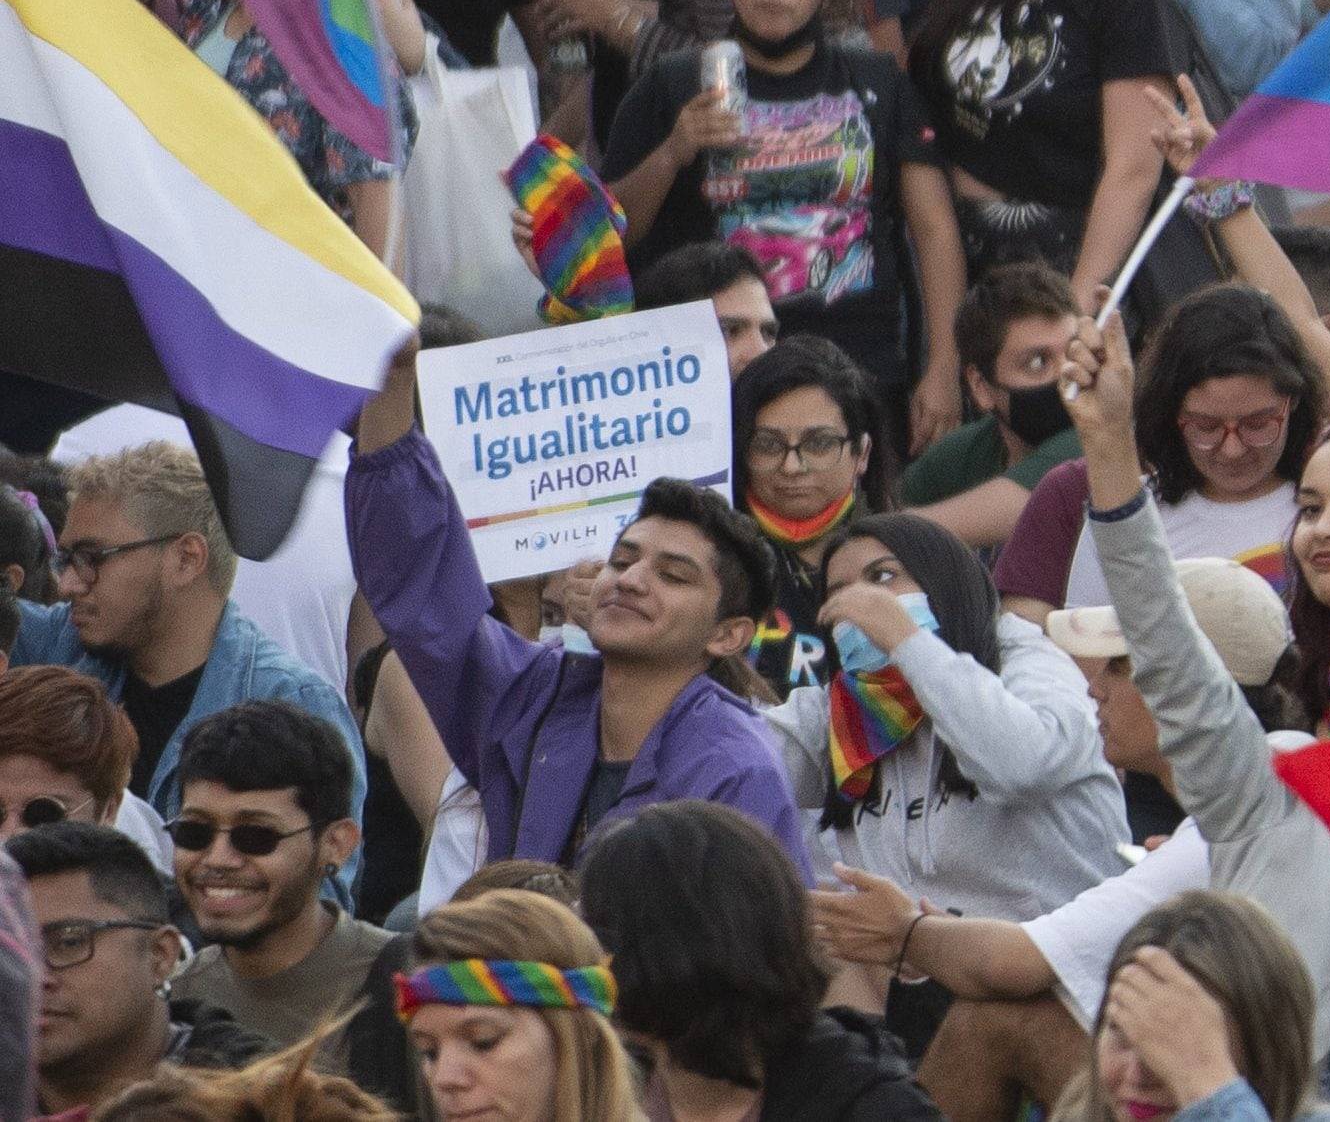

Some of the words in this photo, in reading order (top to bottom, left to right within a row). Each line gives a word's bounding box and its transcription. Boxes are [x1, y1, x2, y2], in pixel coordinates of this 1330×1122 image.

[454, 345, 702, 425] Matrimonio
[473, 399, 692, 480] Igualitario
[530, 456, 638, 501] ¡AHORA!
[514, 525, 598, 551] MOVILH
